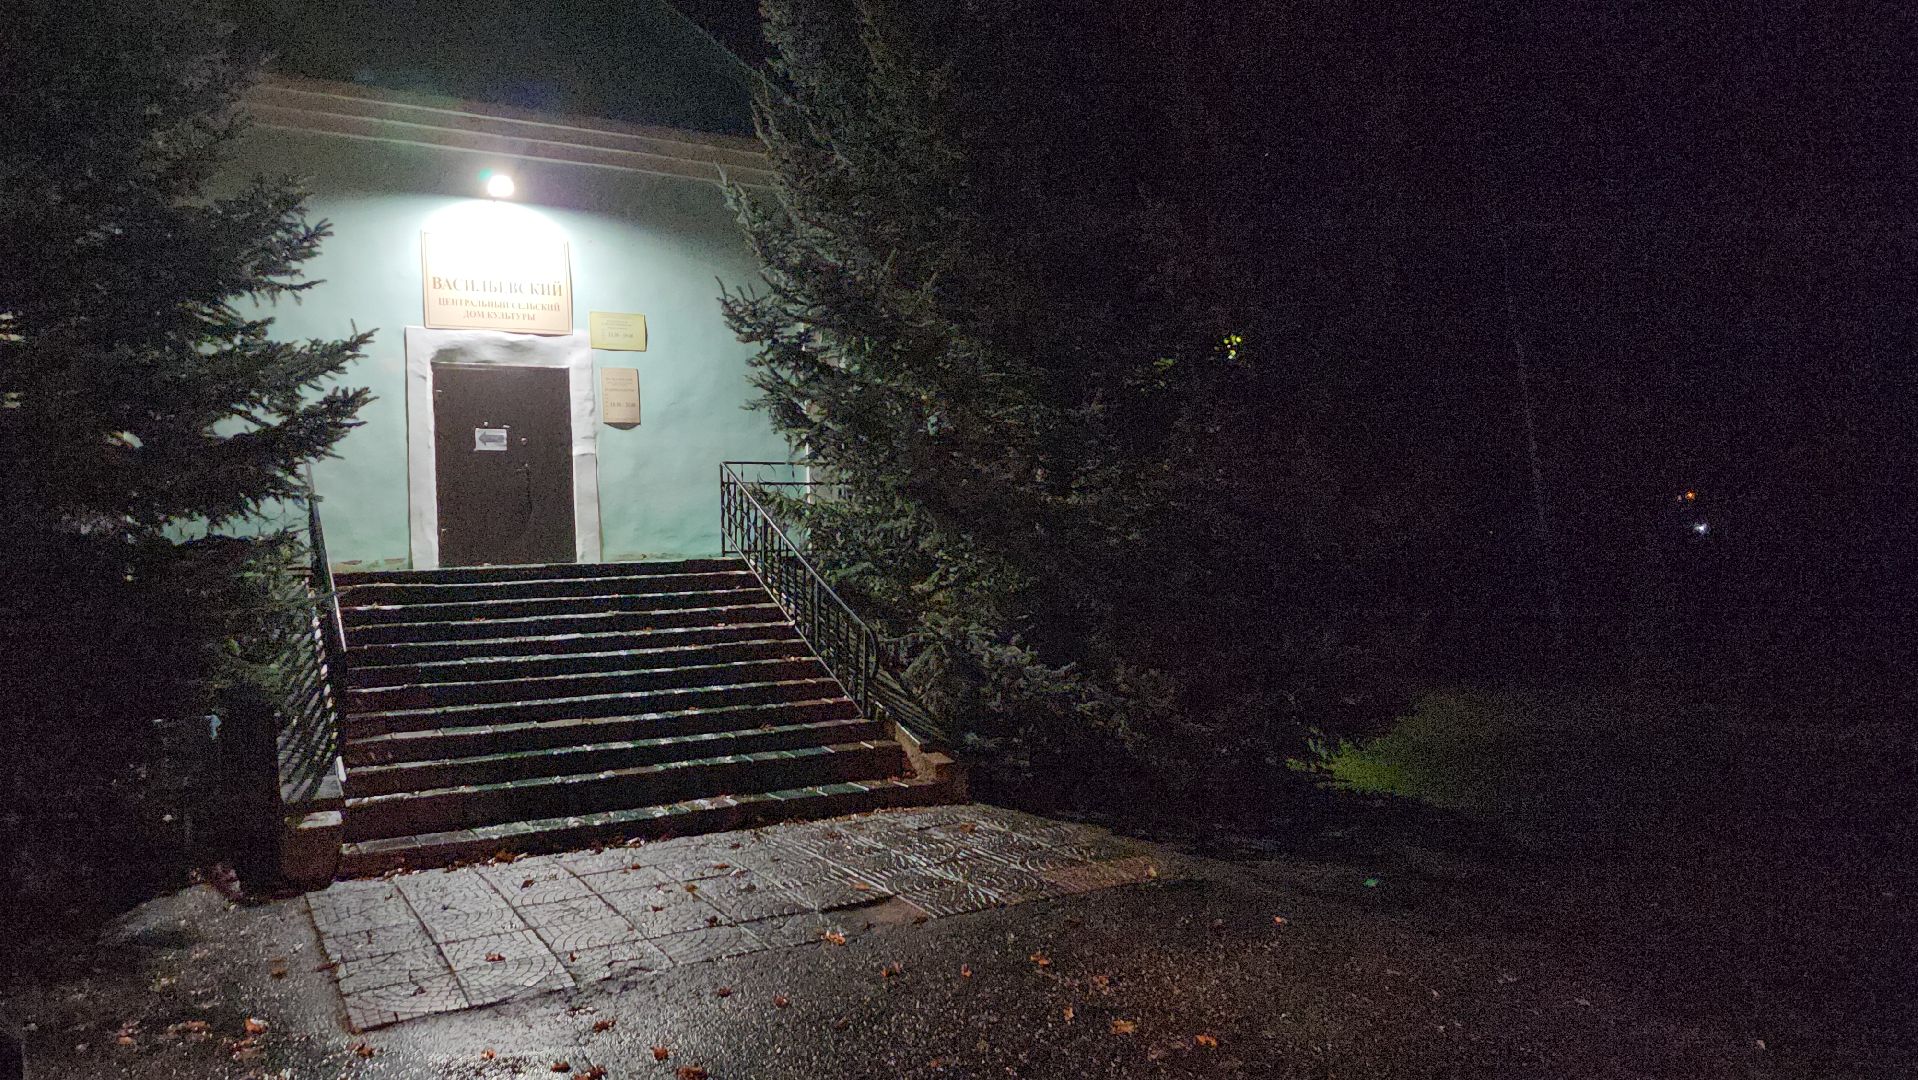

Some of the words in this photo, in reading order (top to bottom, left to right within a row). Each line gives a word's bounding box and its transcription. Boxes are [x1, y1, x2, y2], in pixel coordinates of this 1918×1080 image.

[433, 277, 562, 296] ВАСИЛЬЕВСКИЙ
[464, 310, 485, 320] ДОМ
[487, 311, 536, 320] КУЛЬТУРЫ
